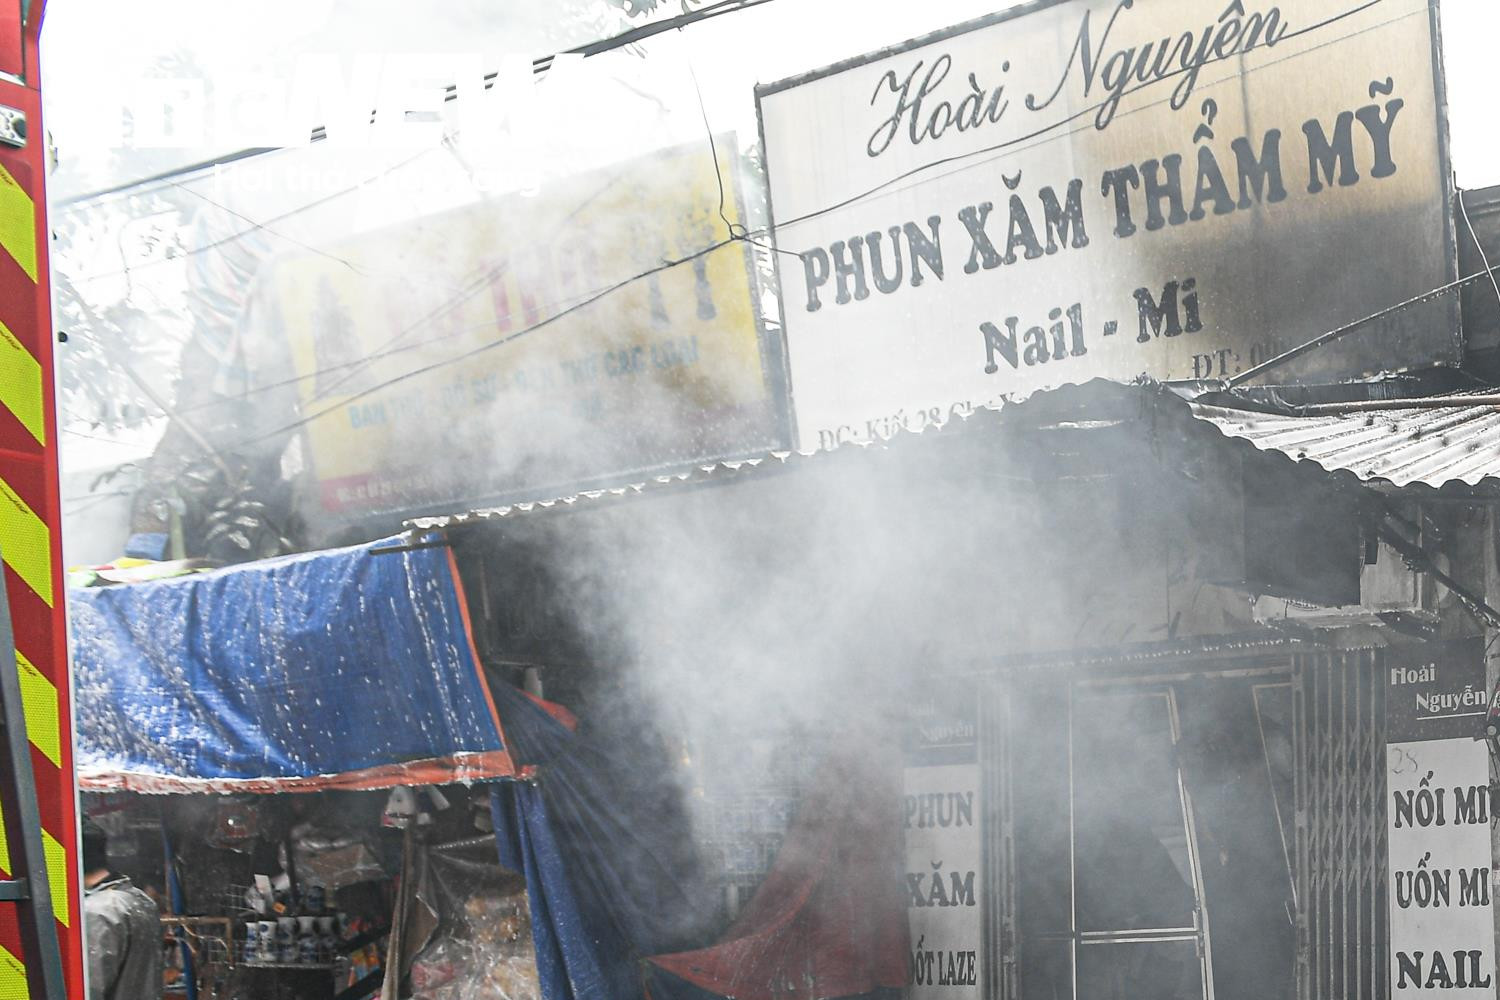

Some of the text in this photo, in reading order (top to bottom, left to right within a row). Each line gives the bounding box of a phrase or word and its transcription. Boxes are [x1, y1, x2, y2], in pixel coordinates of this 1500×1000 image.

[866, 55, 1011, 158] Hoài
[799, 78, 1404, 312] PHUN XĂM THẨM MỸ
[979, 303, 1087, 375] Nail
[1133, 277, 1205, 344] Mi
[1391, 663, 1437, 685] Hoài
[1416, 685, 1487, 713] Nguyễn
[904, 791, 973, 829] PHUN
[1394, 771, 1489, 829] NỐI MI
[906, 860, 975, 907] XĂM
[1396, 852, 1490, 908] UỐN MI
[938, 950, 977, 987] LAZE
[1396, 950, 1491, 989] NAIL
